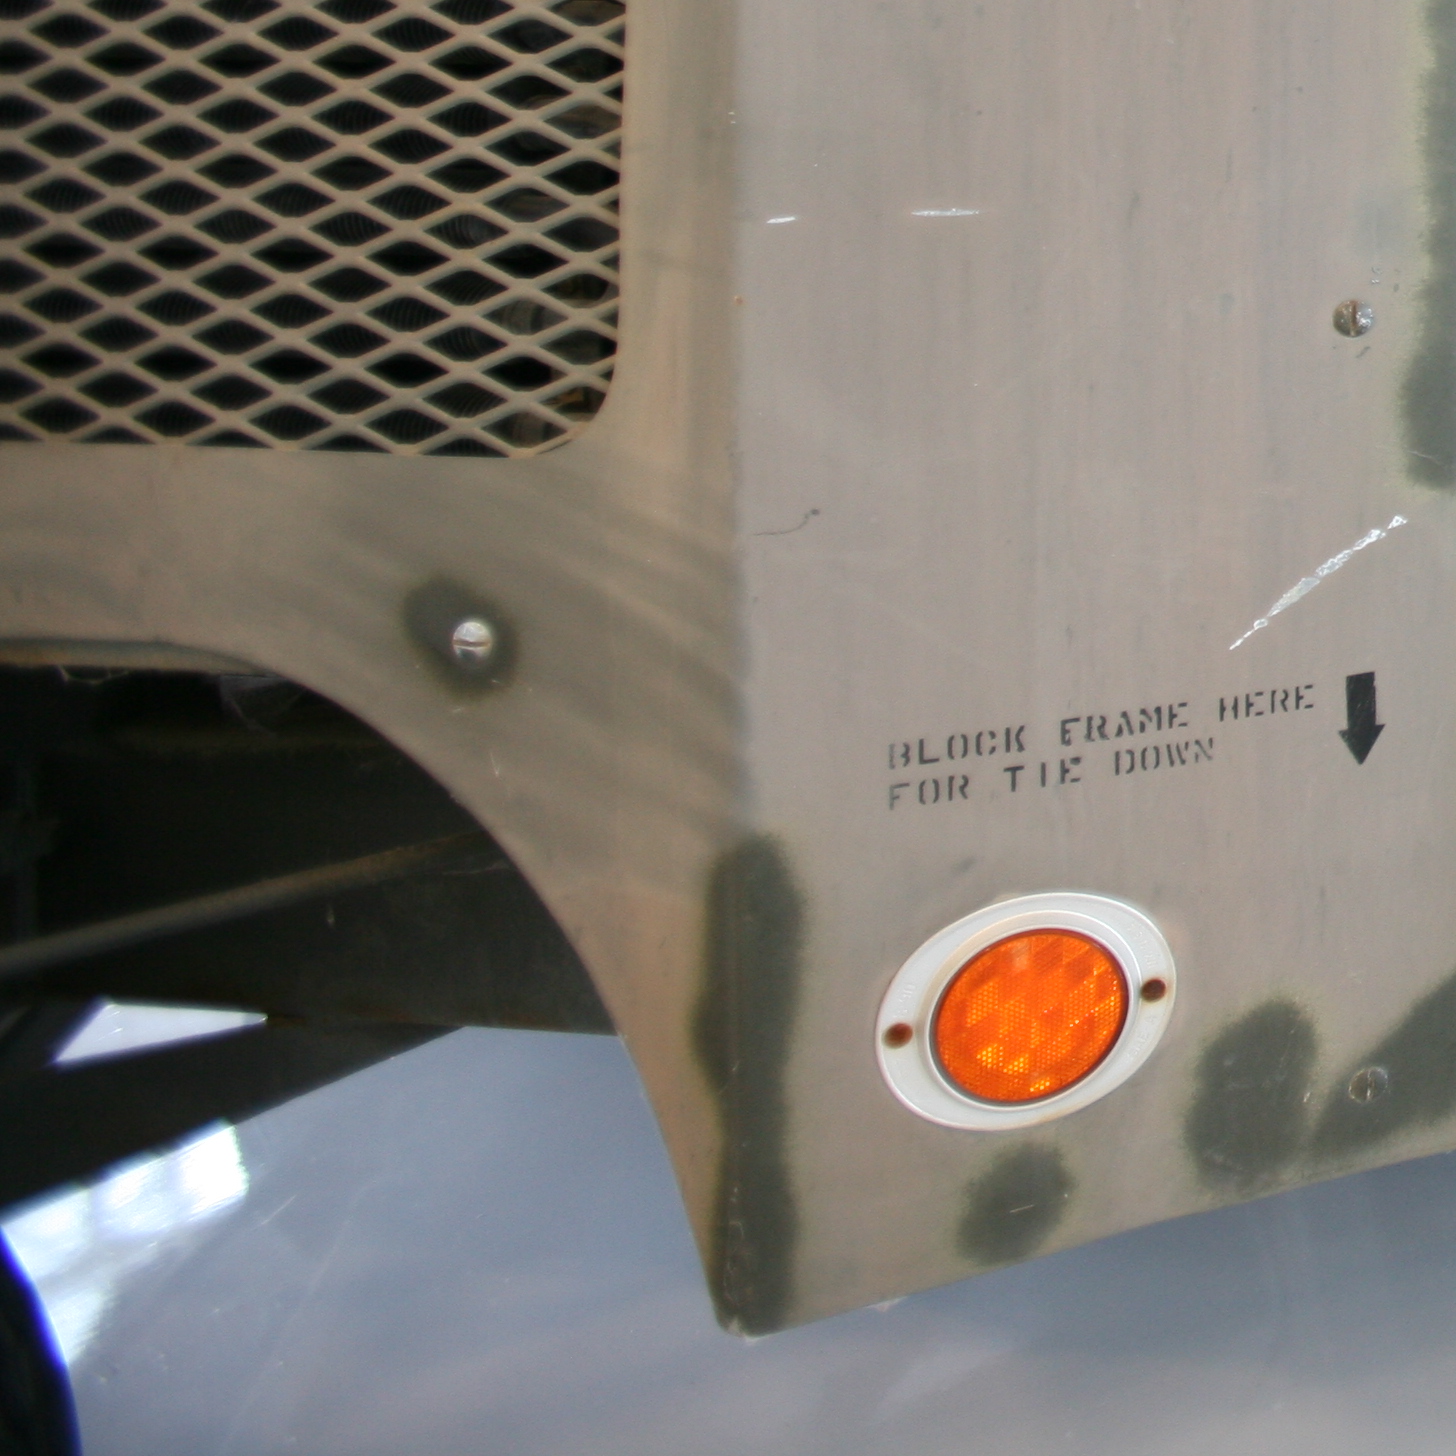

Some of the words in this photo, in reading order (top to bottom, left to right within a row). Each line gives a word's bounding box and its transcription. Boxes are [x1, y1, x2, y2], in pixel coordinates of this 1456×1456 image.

[887, 724, 1027, 770] BLOCK
[1060, 701, 1190, 748] FRAME
[1218, 684, 1315, 723] HERE
[887, 773, 969, 811] FOR
[1003, 755, 1083, 794] TIE
[1114, 737, 1215, 776] DOWN
